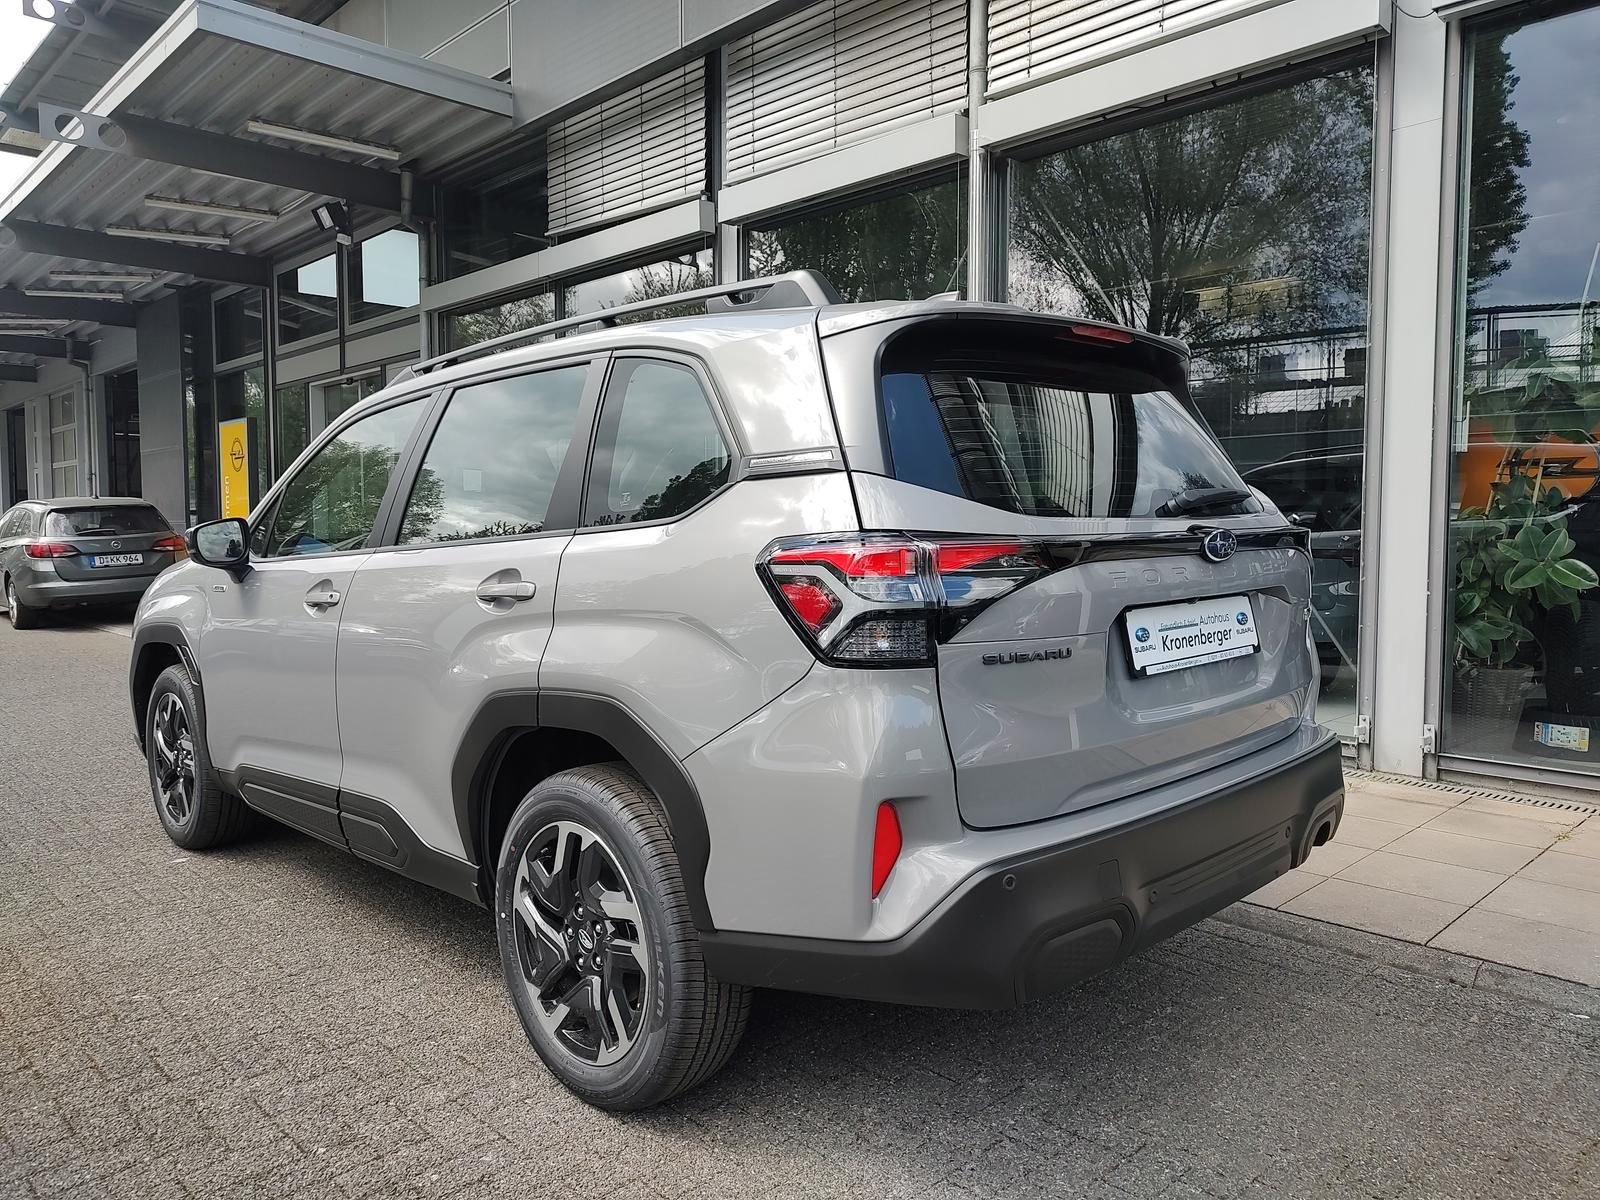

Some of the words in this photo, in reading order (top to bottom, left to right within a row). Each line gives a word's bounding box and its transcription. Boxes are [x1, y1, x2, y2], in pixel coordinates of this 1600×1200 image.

[99, 556, 105, 565] D
[109, 555, 122, 564] KK
[122, 554, 139, 563] 964
[1199, 612, 1230, 626] Autohaus
[1236, 627, 1254, 635] SUBARU
[1161, 626, 1233, 652] Kronenberger
[1134, 644, 1157, 654] SUBARU
[982, 647, 1072, 665] SUBARU
